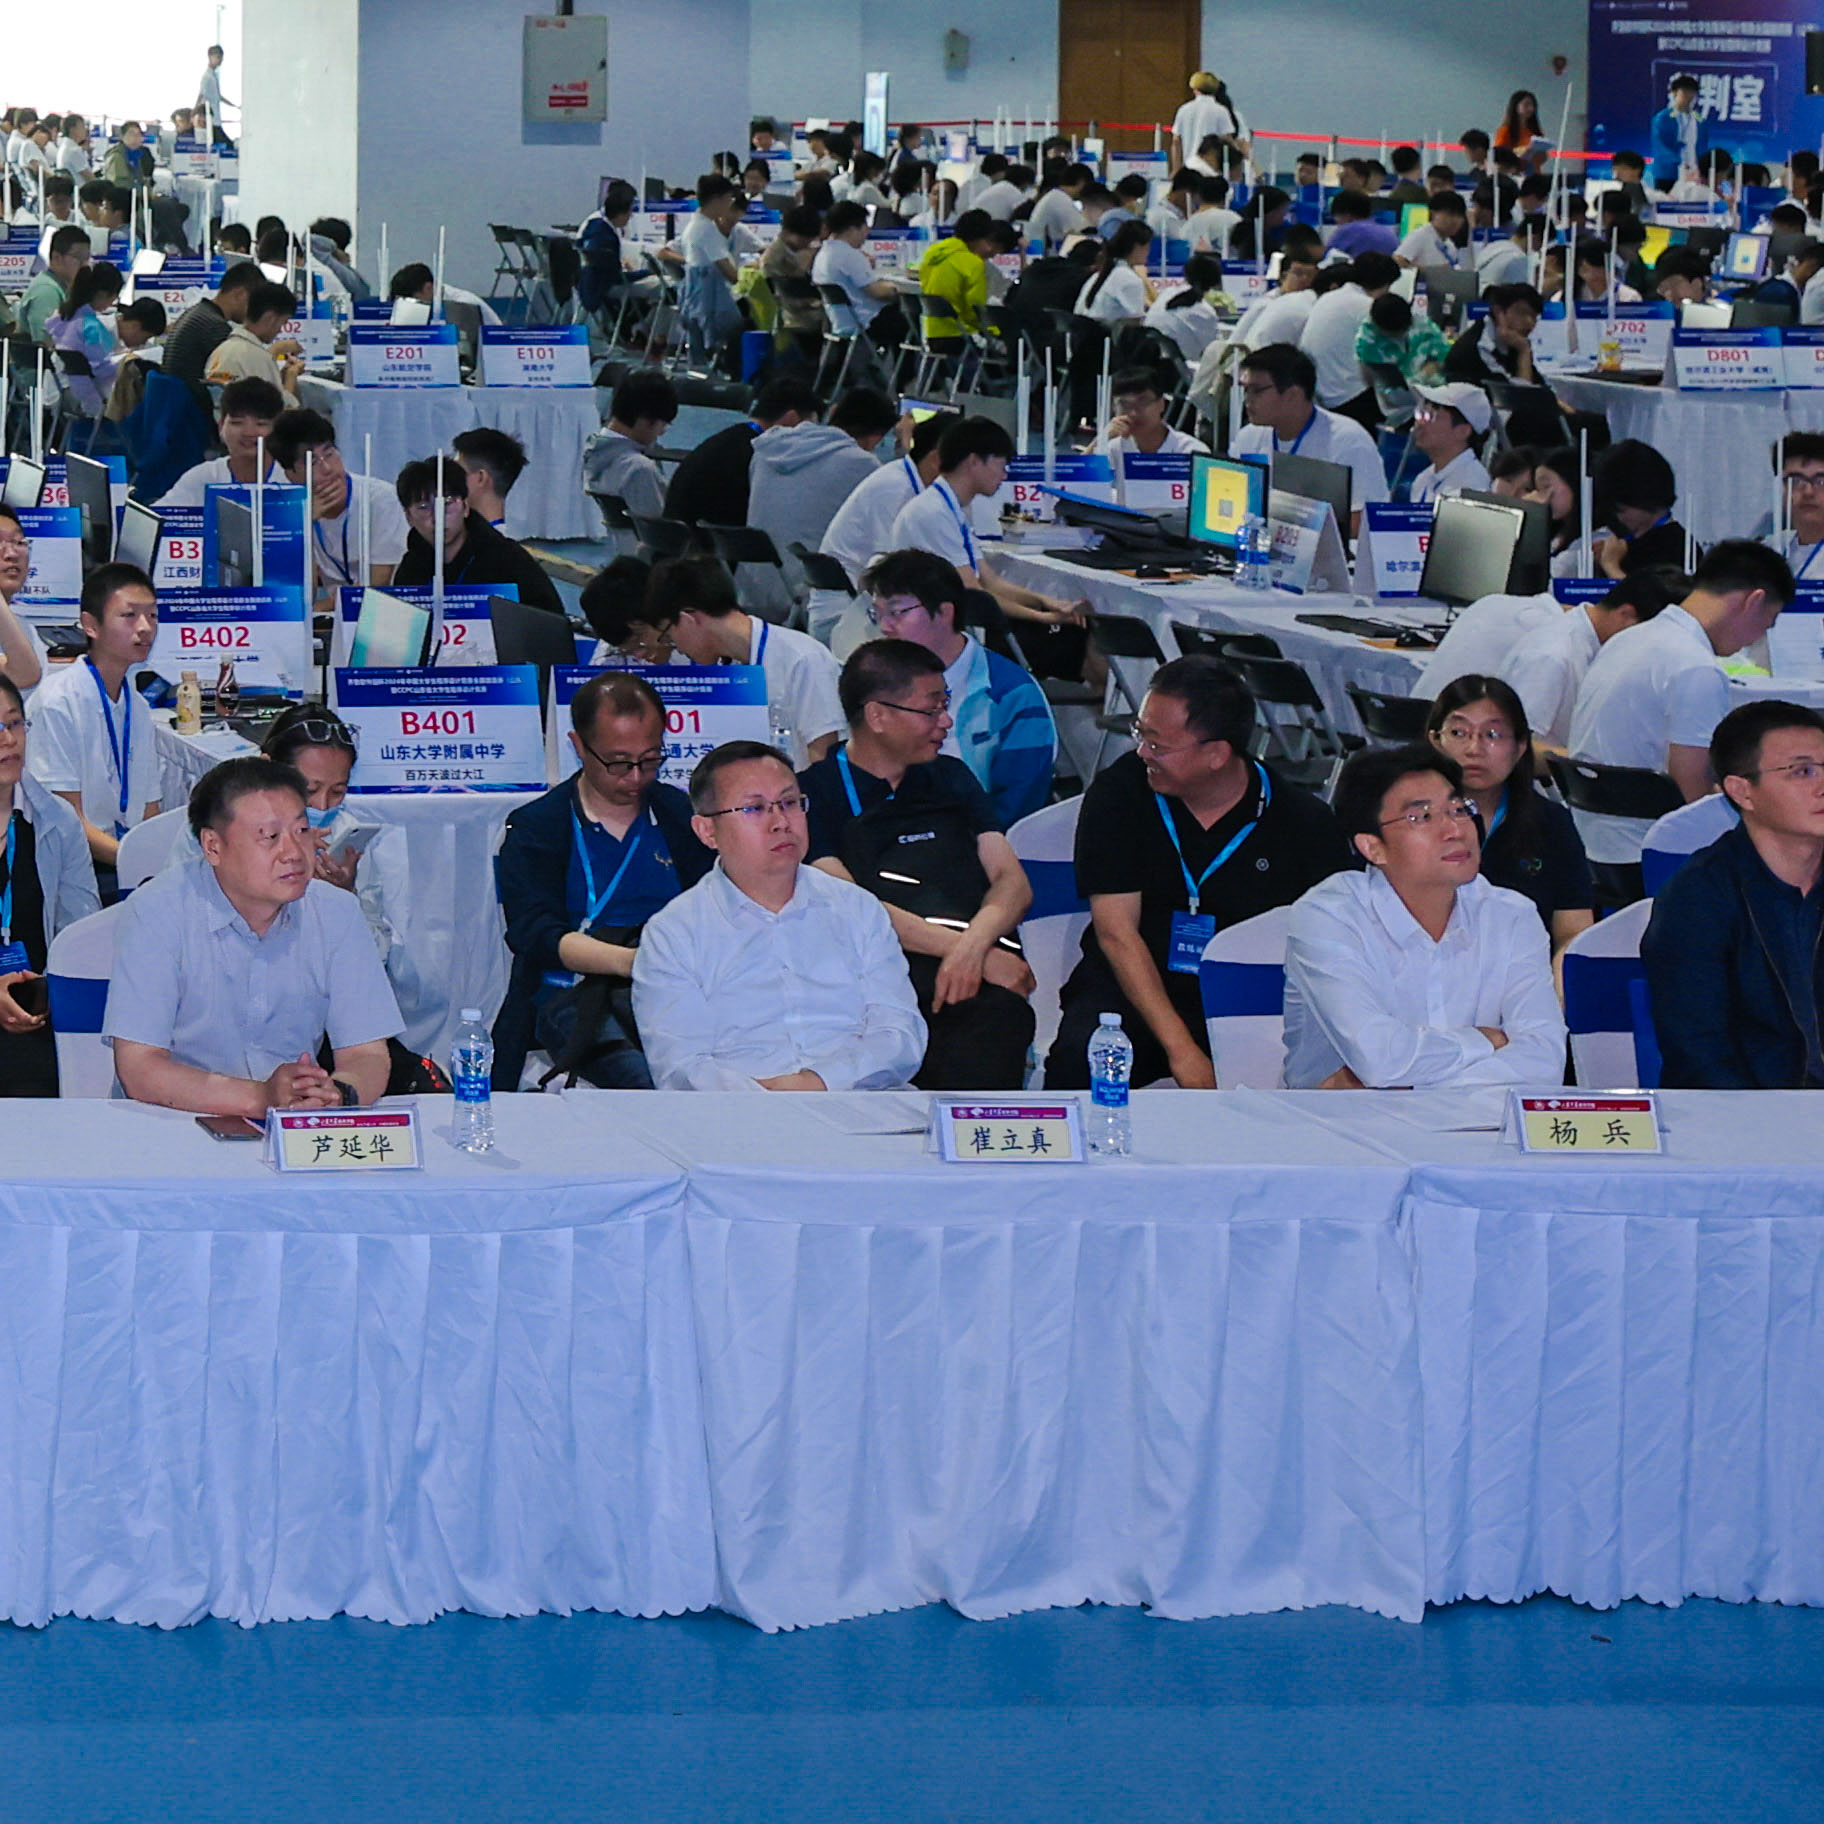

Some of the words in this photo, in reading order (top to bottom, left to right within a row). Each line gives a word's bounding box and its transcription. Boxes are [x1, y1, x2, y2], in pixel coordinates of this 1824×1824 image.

[1668, 72, 1765, 122] 判室
[385, 347, 424, 359] E201
[517, 347, 556, 359] E101
[1707, 349, 1751, 362] D801
[180, 626, 251, 648] B402
[400, 709, 476, 735] B401
[380, 744, 506, 761] 山东大学附属中学
[311, 1134, 395, 1163] 芦延华
[969, 1125, 1054, 1155] 崔立真
